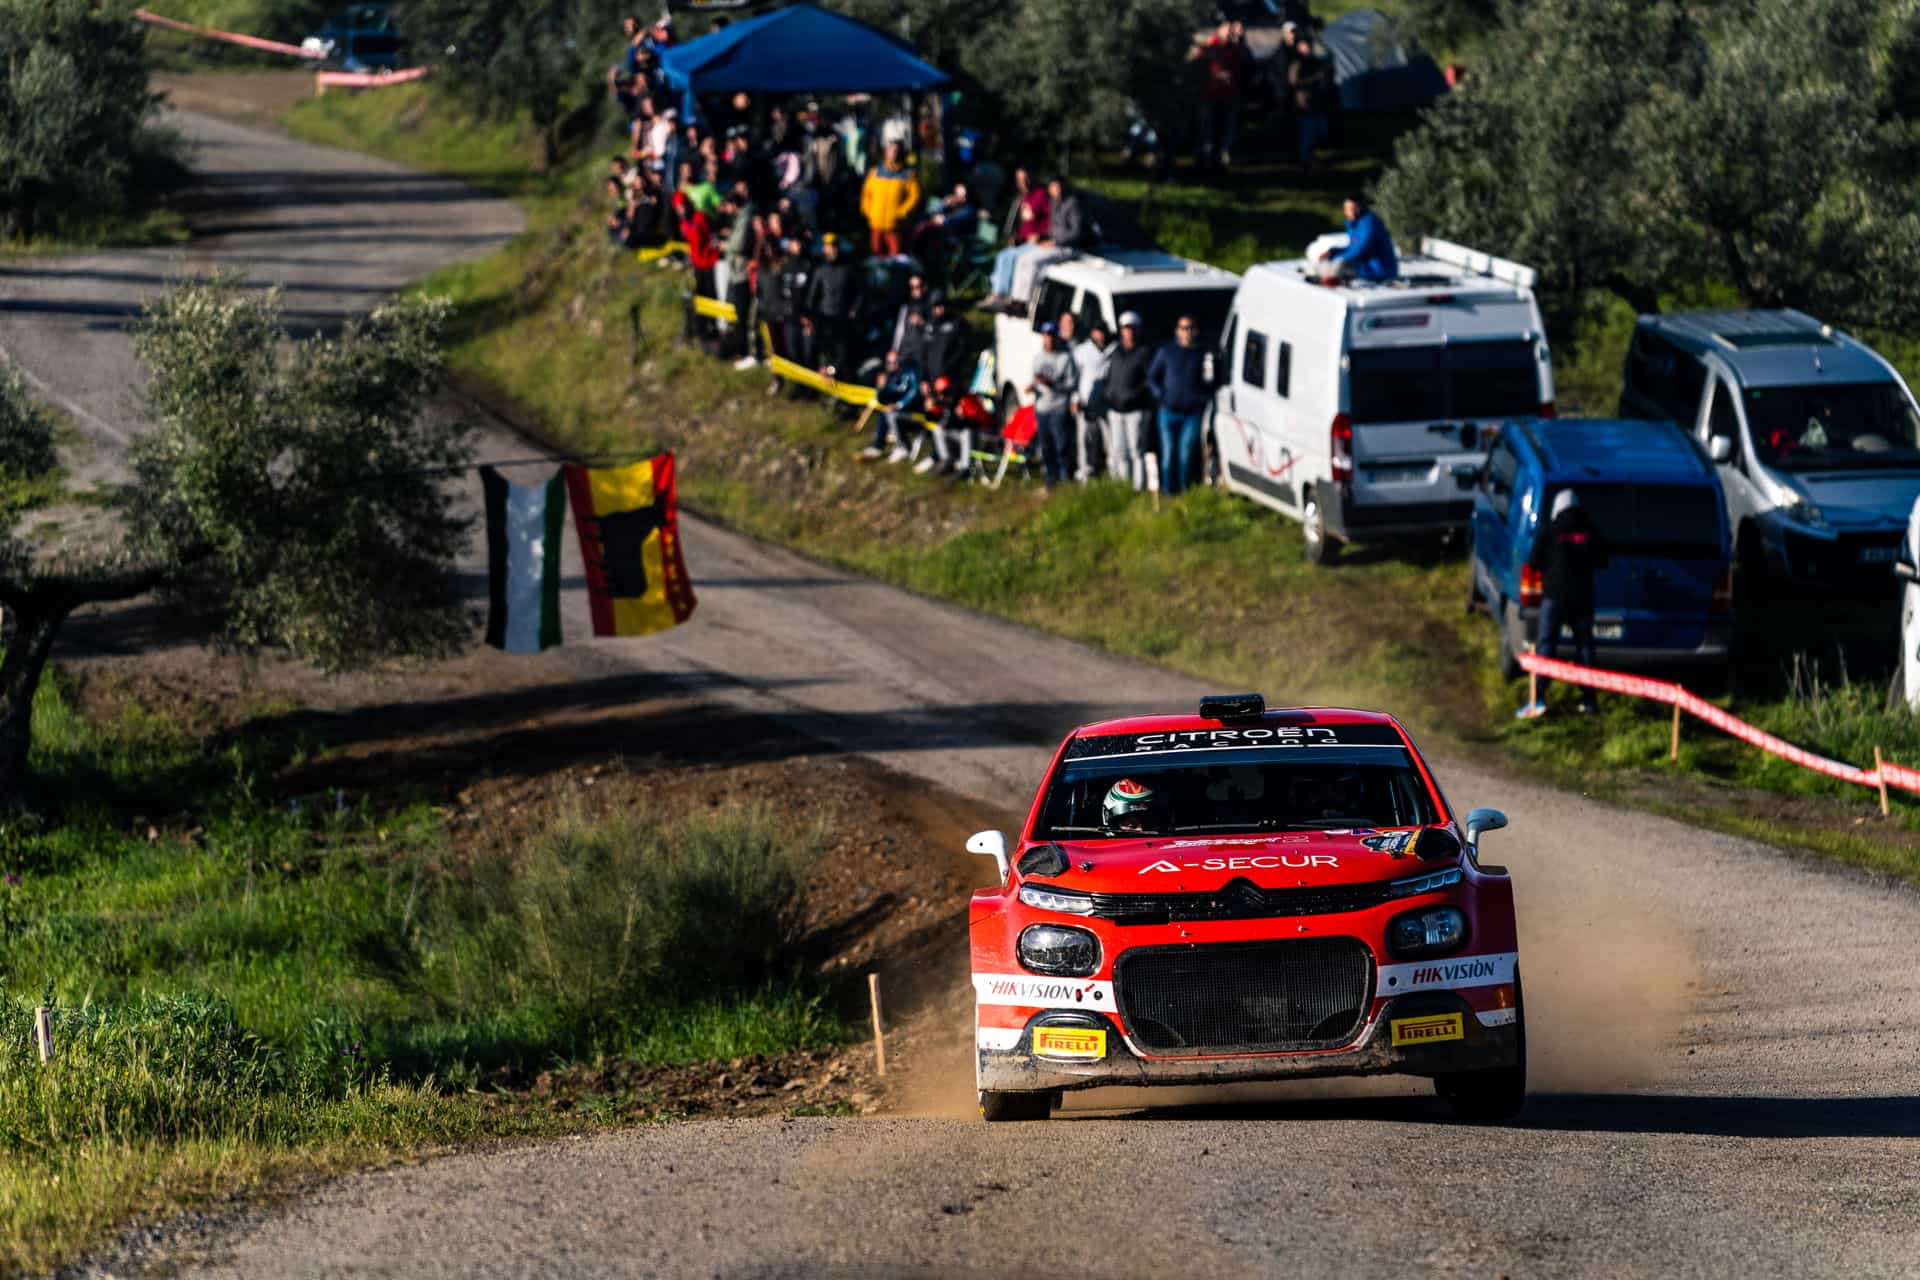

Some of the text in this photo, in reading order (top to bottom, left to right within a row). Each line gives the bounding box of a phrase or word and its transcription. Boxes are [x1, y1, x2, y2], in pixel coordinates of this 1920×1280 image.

[1137, 855, 1340, 875] A-SECUR
[1412, 960, 1495, 985] HIKVISION
[991, 981, 1074, 1000] HIKVISION
[1397, 1018, 1457, 1040] PIRELLI
[1039, 1033, 1099, 1051] PIRELLI
